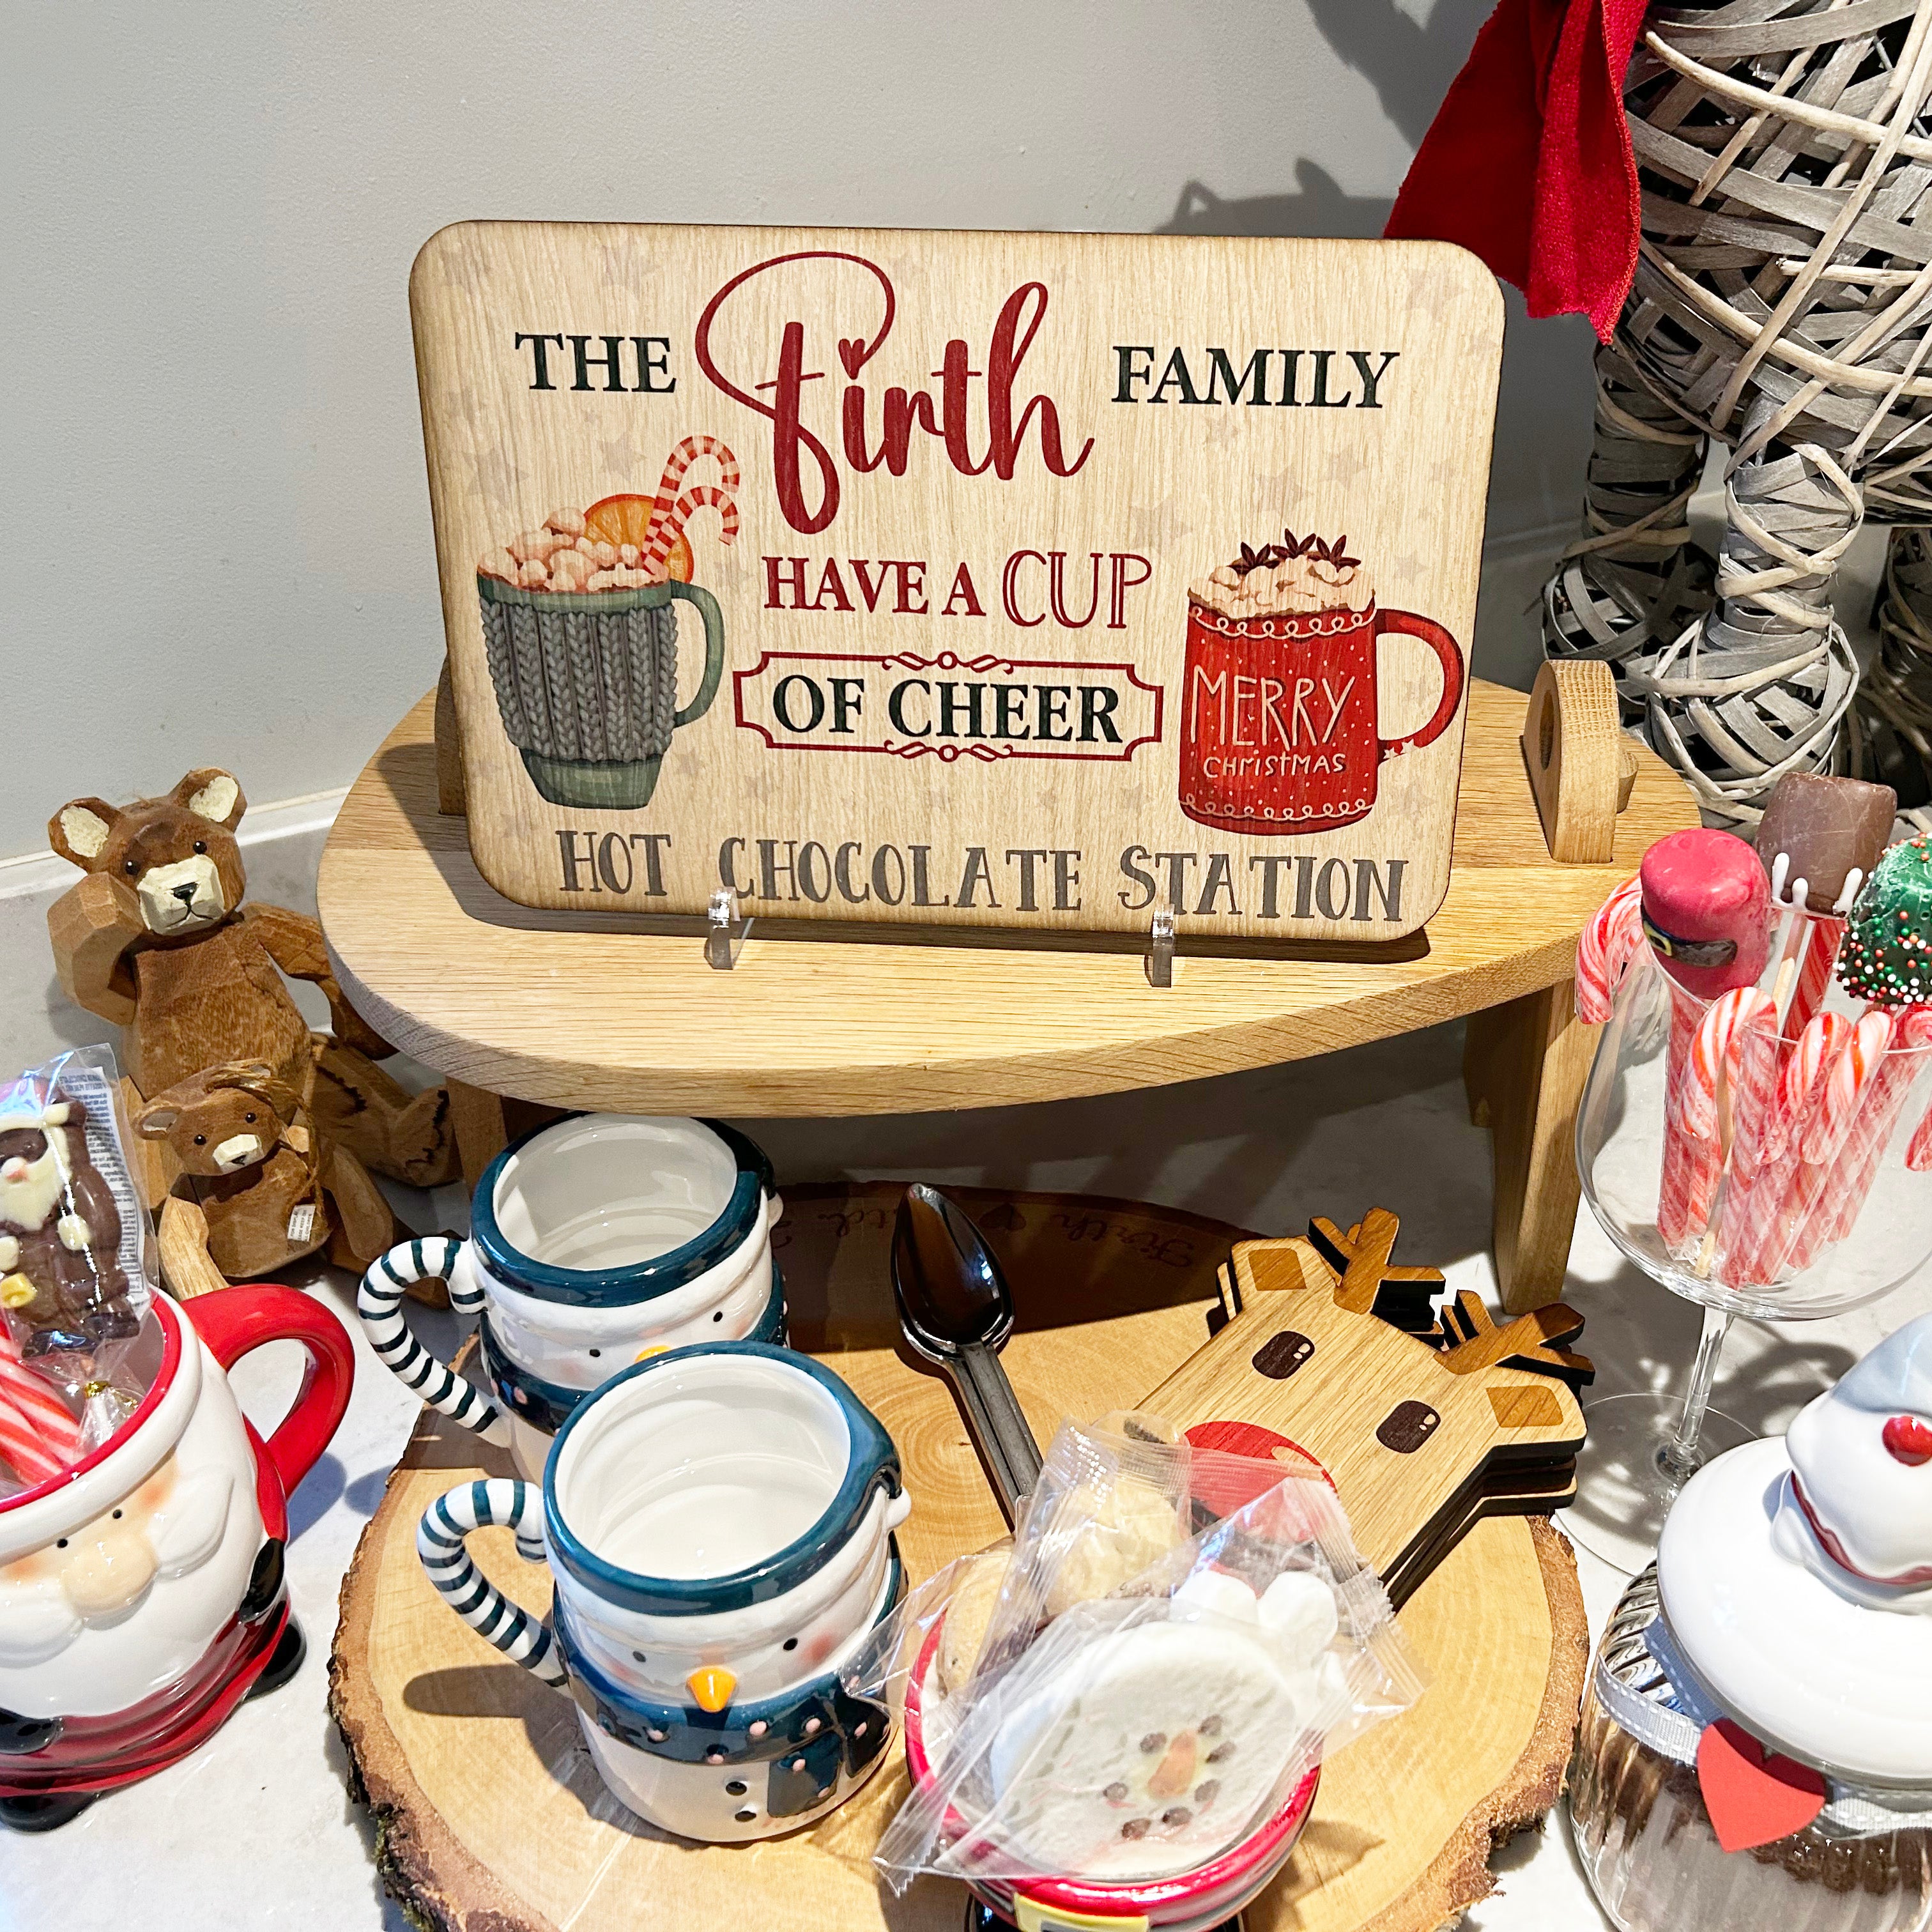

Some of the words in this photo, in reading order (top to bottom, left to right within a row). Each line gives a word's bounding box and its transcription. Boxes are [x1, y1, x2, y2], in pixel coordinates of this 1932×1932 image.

[514, 332, 677, 394] THE
[695, 251, 1095, 535] Firth
[1111, 345, 1400, 409] FAMILY
[762, 556, 929, 615] HAVE
[941, 562, 986, 617] A
[1002, 550, 1152, 629] CUP
[772, 675, 865, 733] OF
[888, 679, 1123, 744] CHEER
[1190, 664, 1356, 751] MERRY
[555, 830, 671, 896] HOT
[718, 836, 1082, 912] CHOCOLATE
[1117, 845, 1409, 922] STATION
